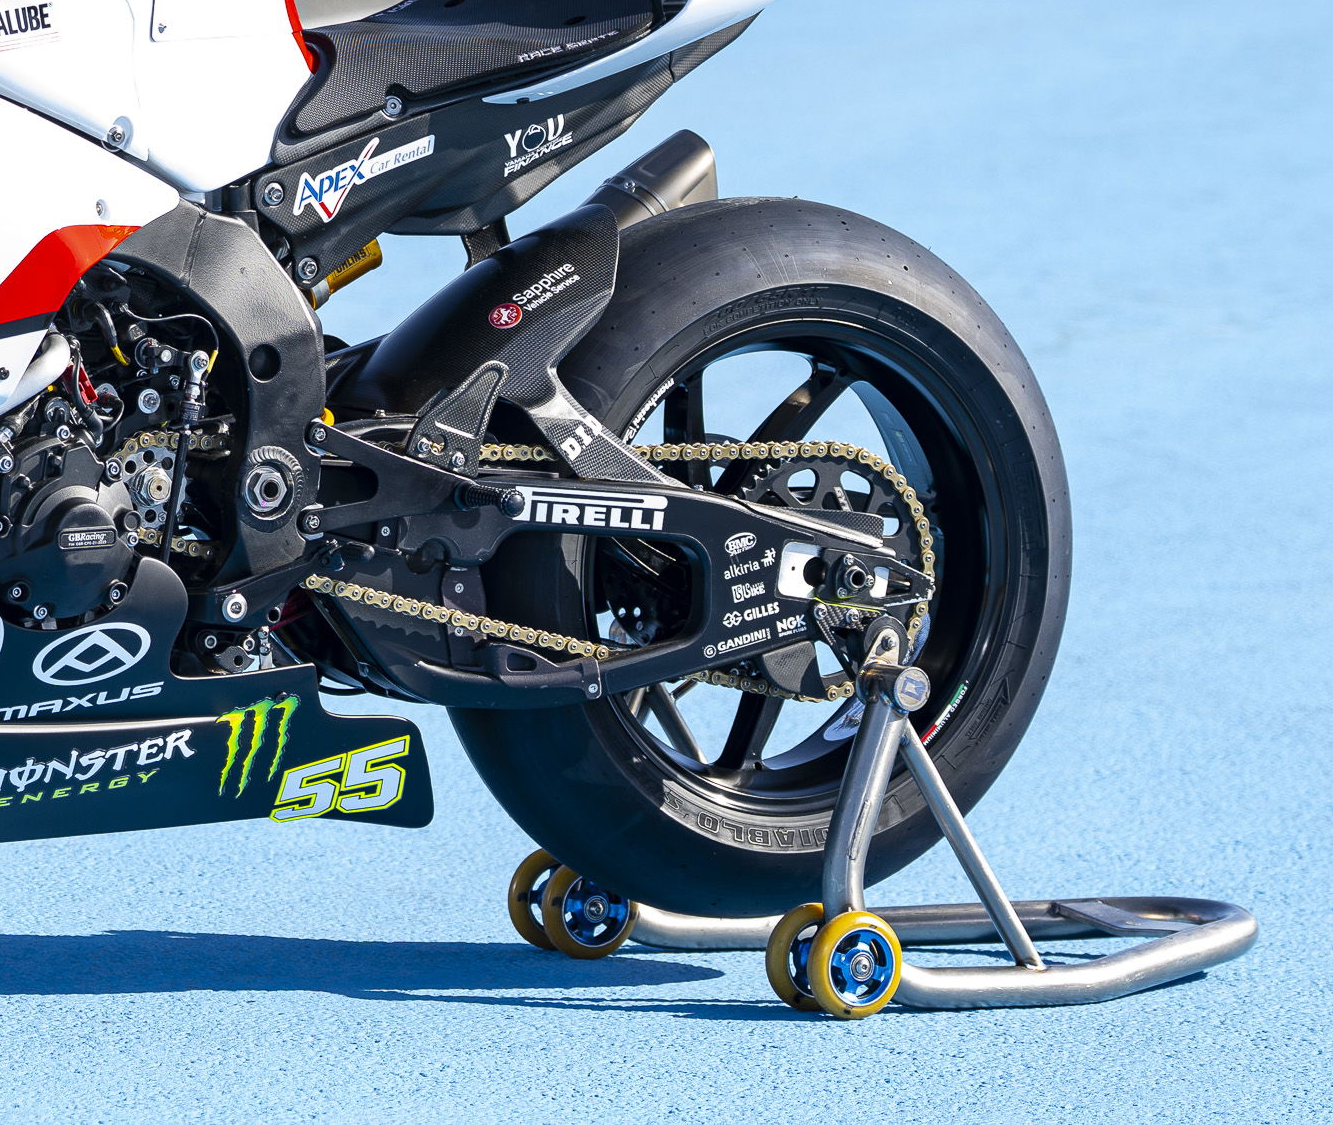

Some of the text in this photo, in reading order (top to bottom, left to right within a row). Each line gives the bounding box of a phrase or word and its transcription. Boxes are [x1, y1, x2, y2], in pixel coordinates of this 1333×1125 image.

[504, 113, 565, 158] YOU
[504, 131, 574, 178] FINANCE
[299, 139, 431, 213] APEX Car Rental
[512, 262, 575, 306] Sapphire
[523, 274, 581, 313] Vehicle Service
[512, 485, 669, 531] PIRELLI
[68, 532, 107, 542] GBRacing
[728, 536, 754, 551] BMC
[724, 560, 761, 580] alkiria
[743, 601, 780, 622] GILLES
[776, 614, 807, 633] NGK
[717, 628, 767, 652] GANDINI
[922, 685, 969, 747] FORGED ALUMINIUM
[269, 735, 411, 823] 55
